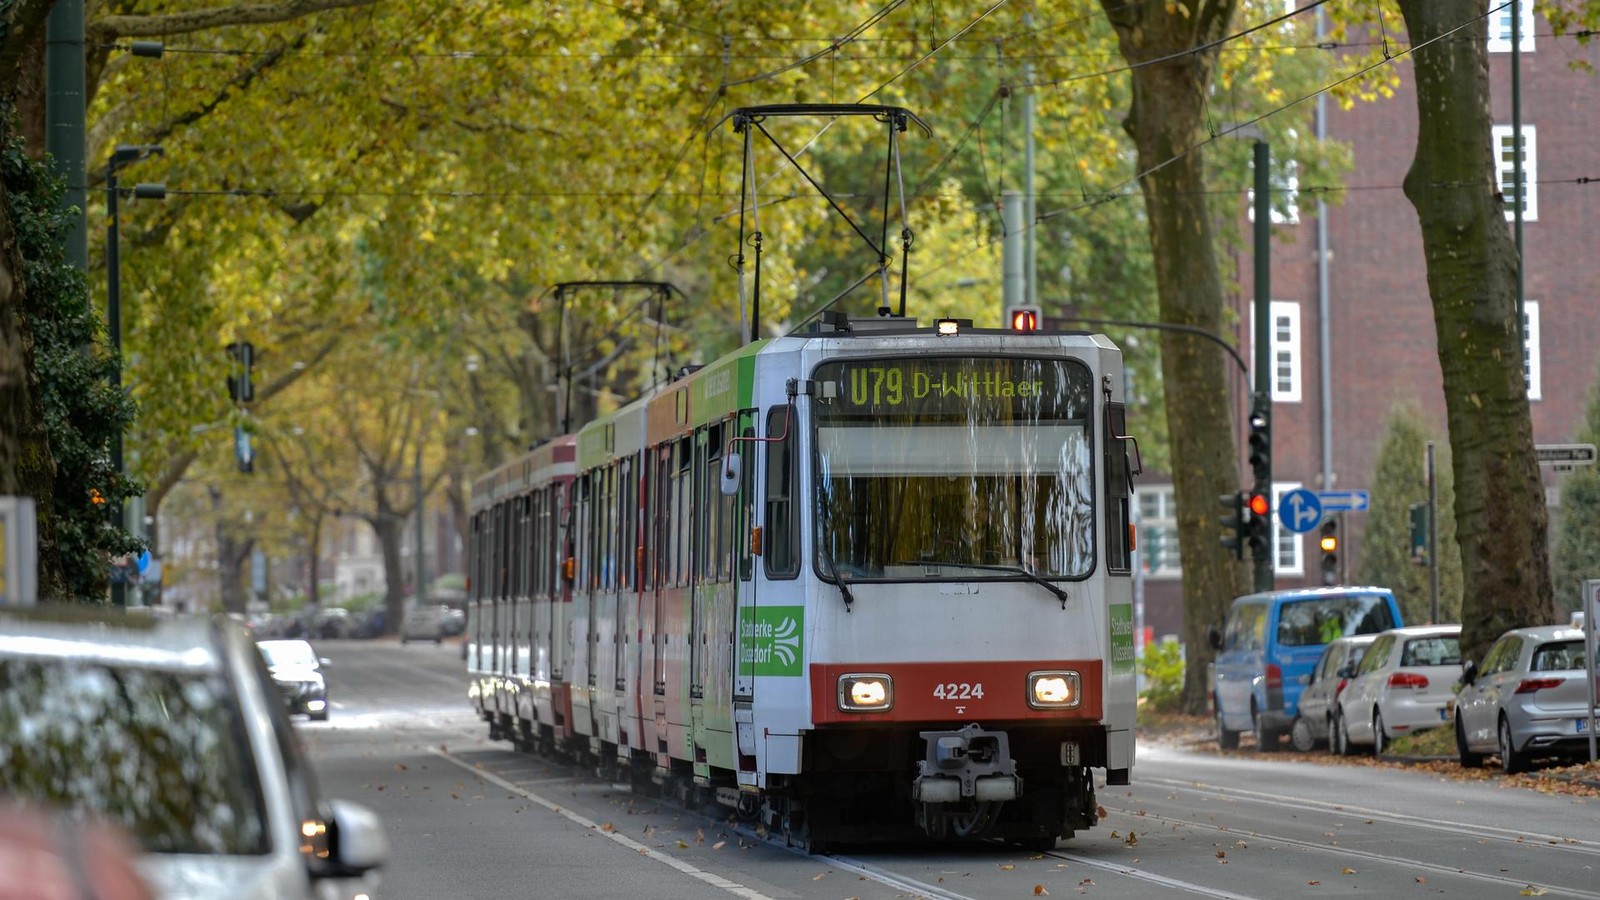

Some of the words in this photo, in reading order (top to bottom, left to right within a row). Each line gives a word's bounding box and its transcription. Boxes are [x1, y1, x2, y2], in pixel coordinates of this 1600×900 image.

[850, 368, 903, 405] U79
[912, 371, 1043, 399] D-Wittlaer
[933, 683, 984, 699] 4224
